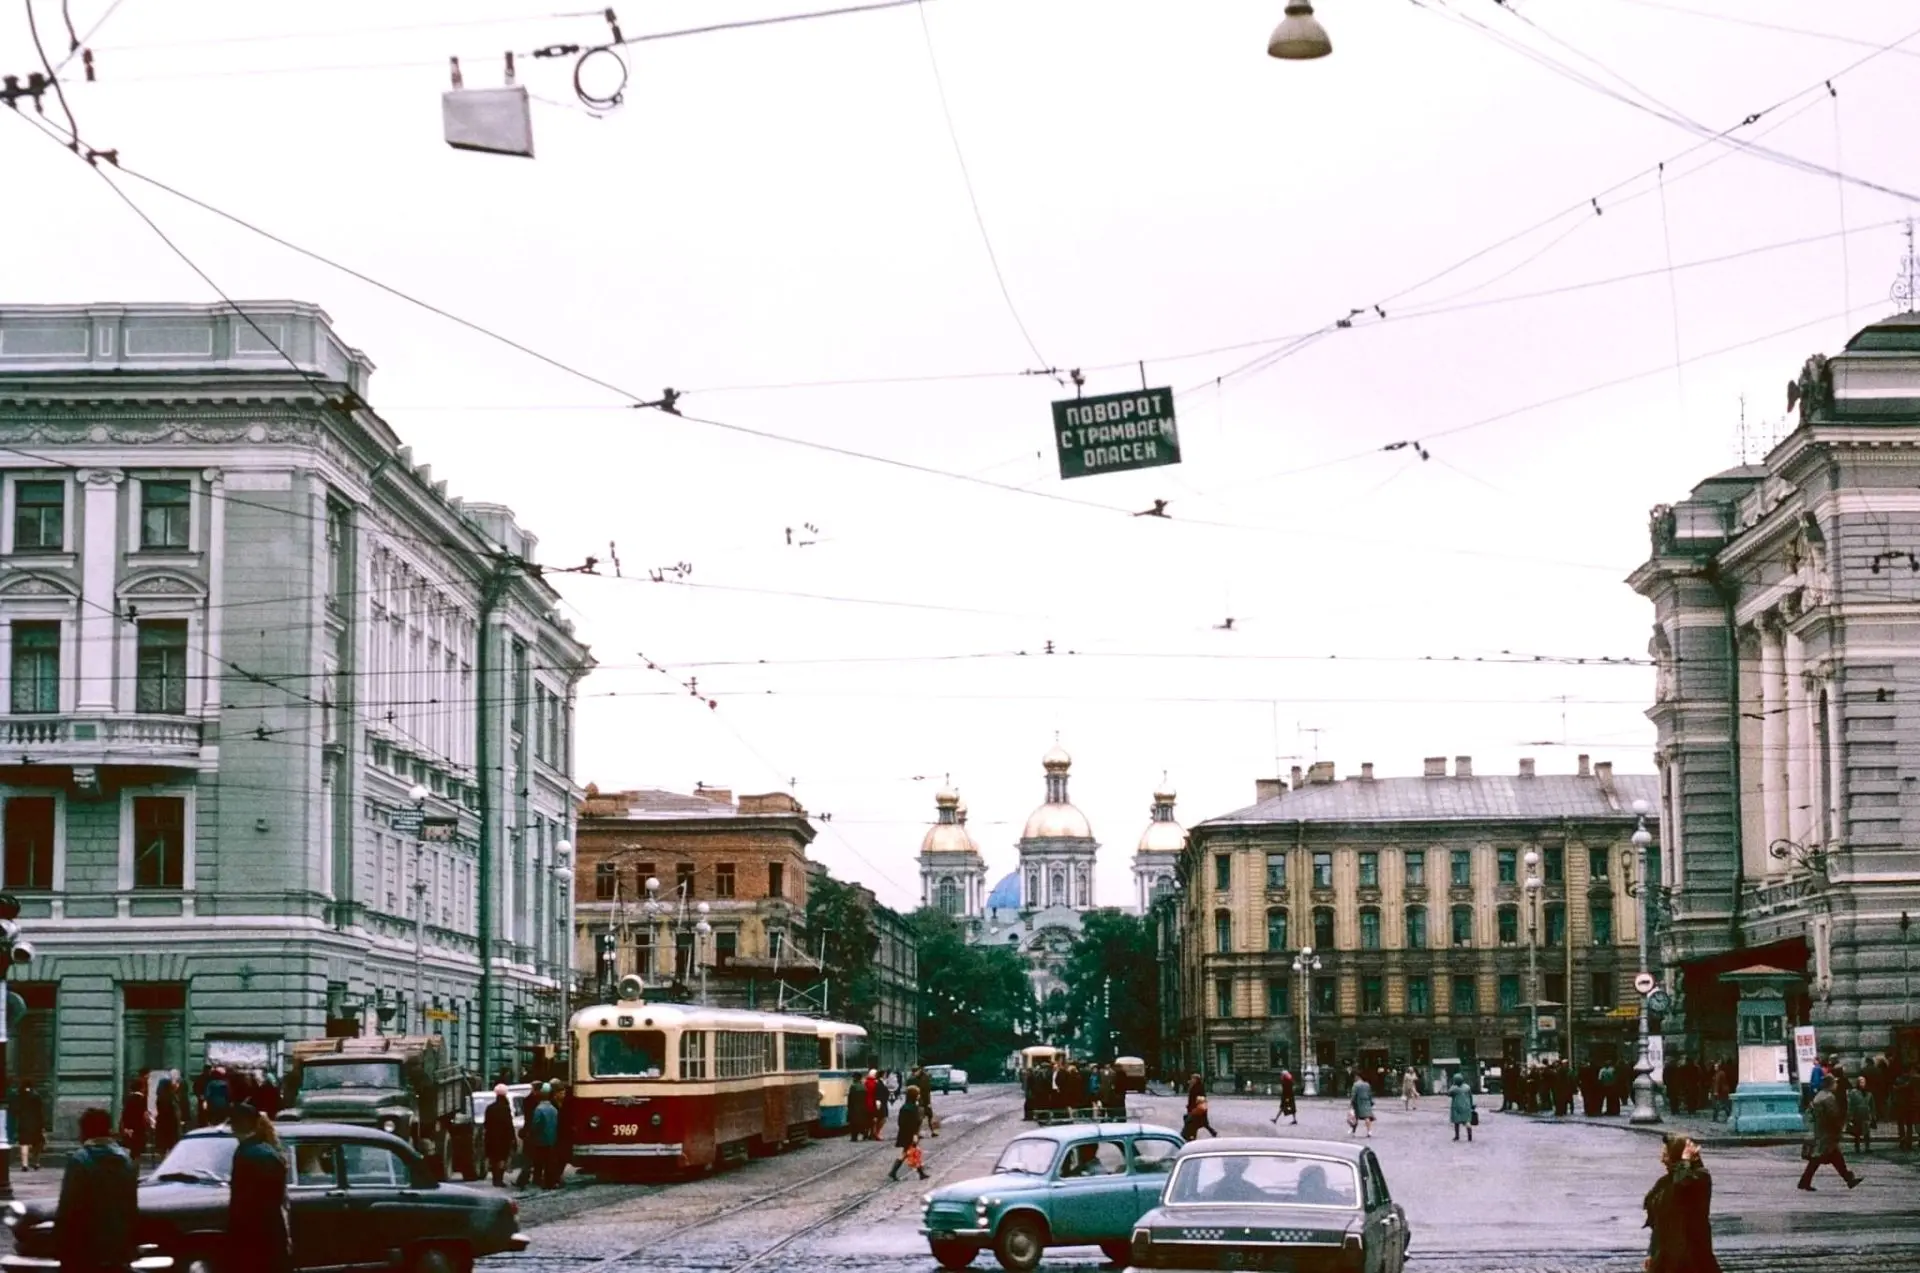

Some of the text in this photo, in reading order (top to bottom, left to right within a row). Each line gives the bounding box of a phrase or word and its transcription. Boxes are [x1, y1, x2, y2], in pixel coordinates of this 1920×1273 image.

[1066, 396, 1163, 427] ПОВОРОТ
[1061, 417, 1174, 448] С ТРАМВАЕМ
[1084, 441, 1158, 467] ОПАСЕН
[612, 1123, 639, 1136] 3969
